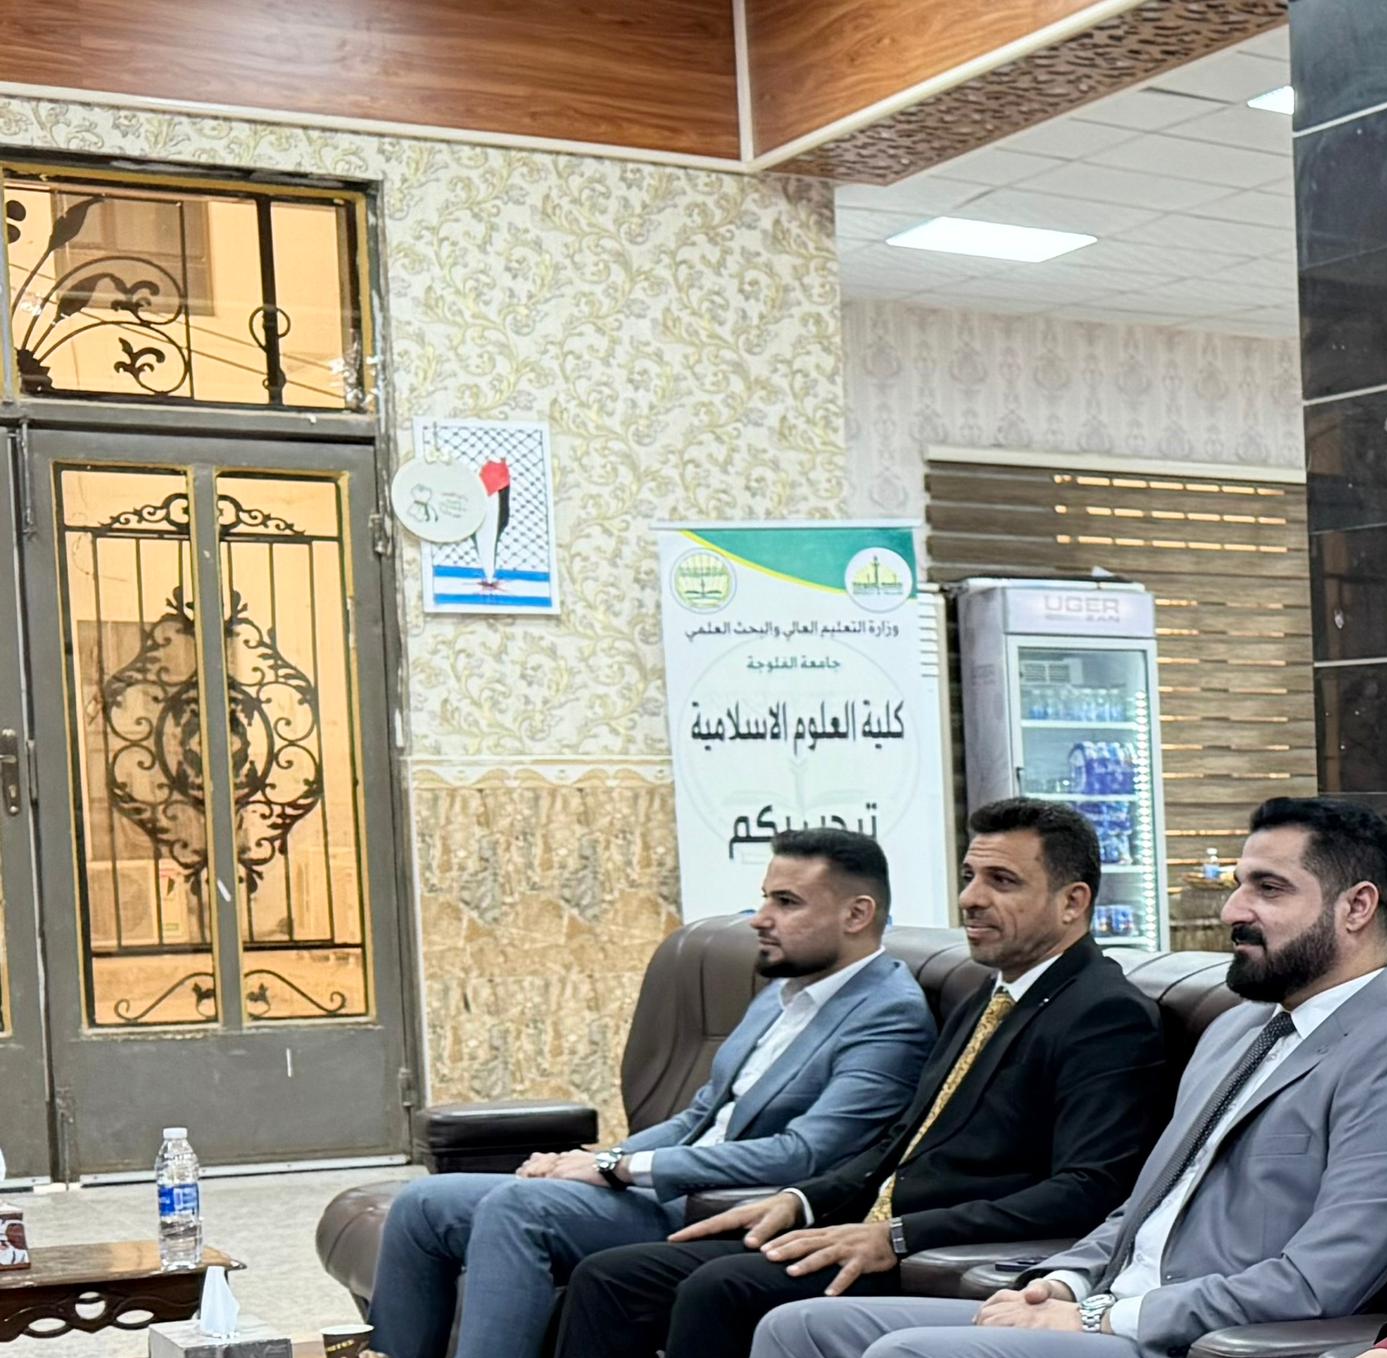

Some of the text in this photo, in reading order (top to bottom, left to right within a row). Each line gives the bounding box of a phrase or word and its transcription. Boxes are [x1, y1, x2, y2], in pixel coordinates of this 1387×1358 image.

[685, 620, 900, 643] وزارة التعليم العالي والبحث العلمي
[747, 654, 841, 673] جامعة الفلوجة
[691, 699, 905, 756] كلية العلوم الاسلامية
